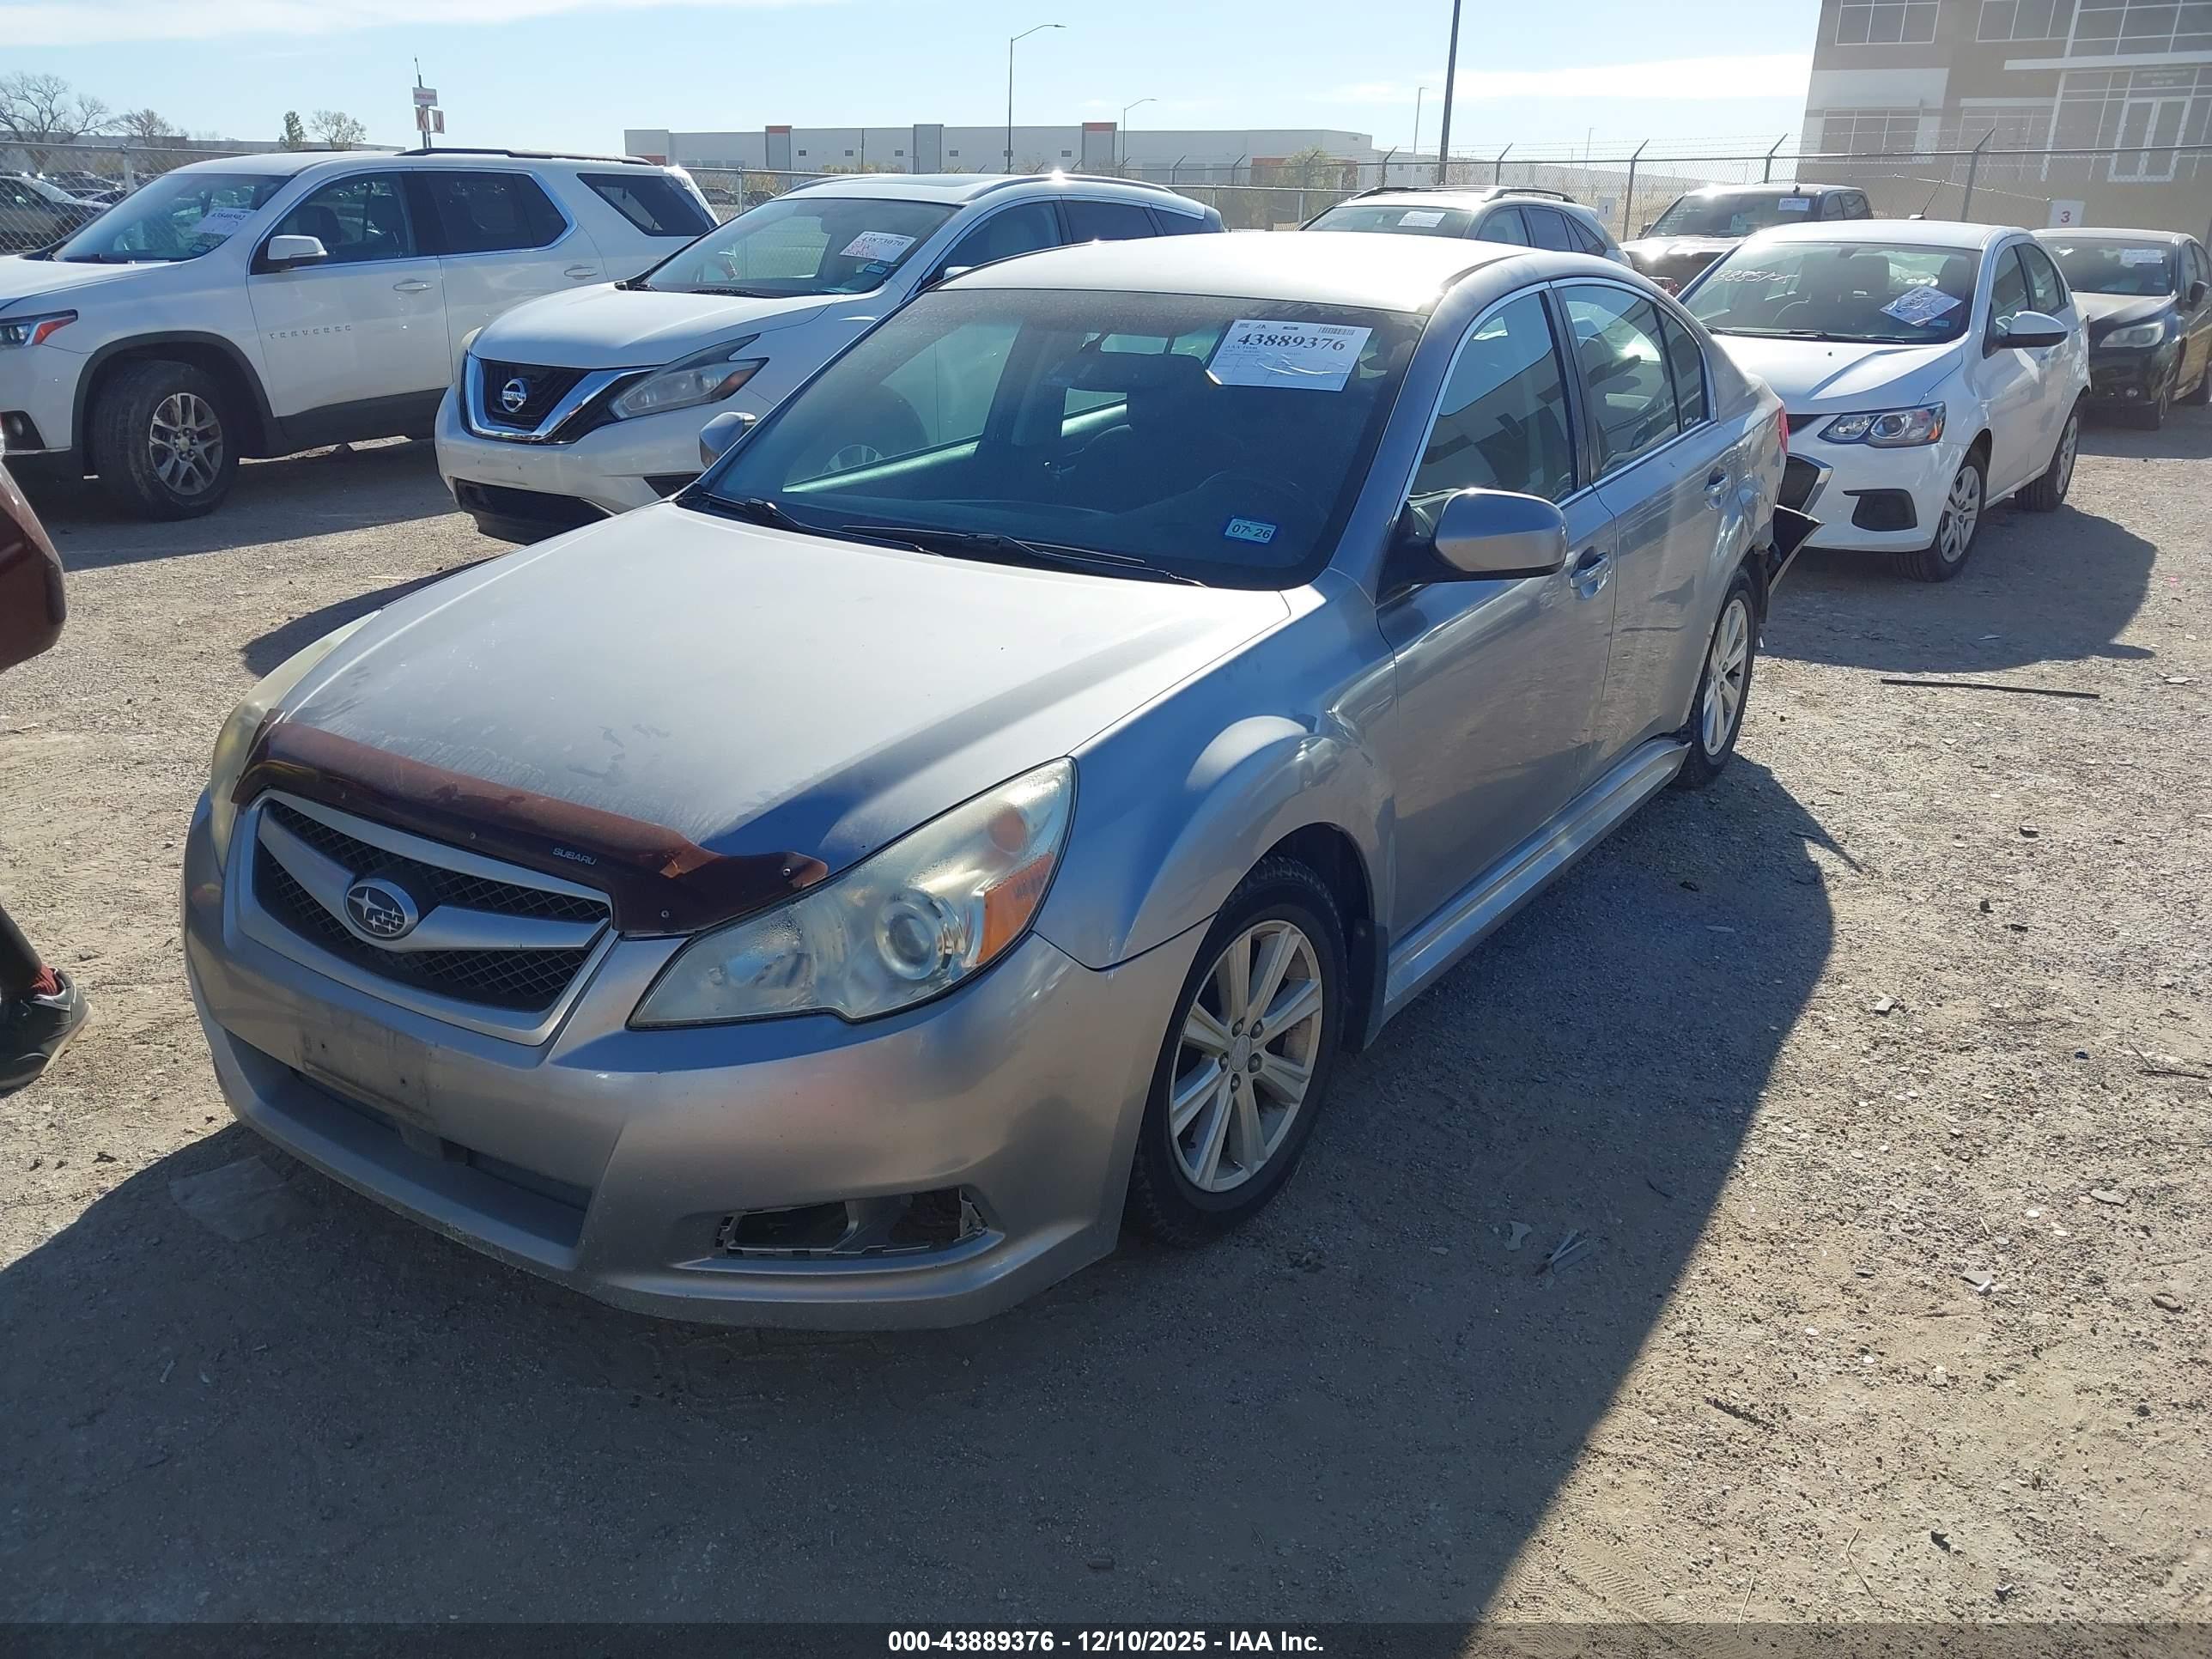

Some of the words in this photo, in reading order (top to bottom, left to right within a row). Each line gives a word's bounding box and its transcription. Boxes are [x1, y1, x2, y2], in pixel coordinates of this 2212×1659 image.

[417, 109, 428, 130] K
[434, 112, 442, 131] J
[2061, 210, 2071, 223] 3
[1237, 332, 1347, 352] 43889376
[1232, 525, 1250, 534] 07
[1254, 528, 1272, 539] 26
[552, 848, 598, 866] SUBARU
